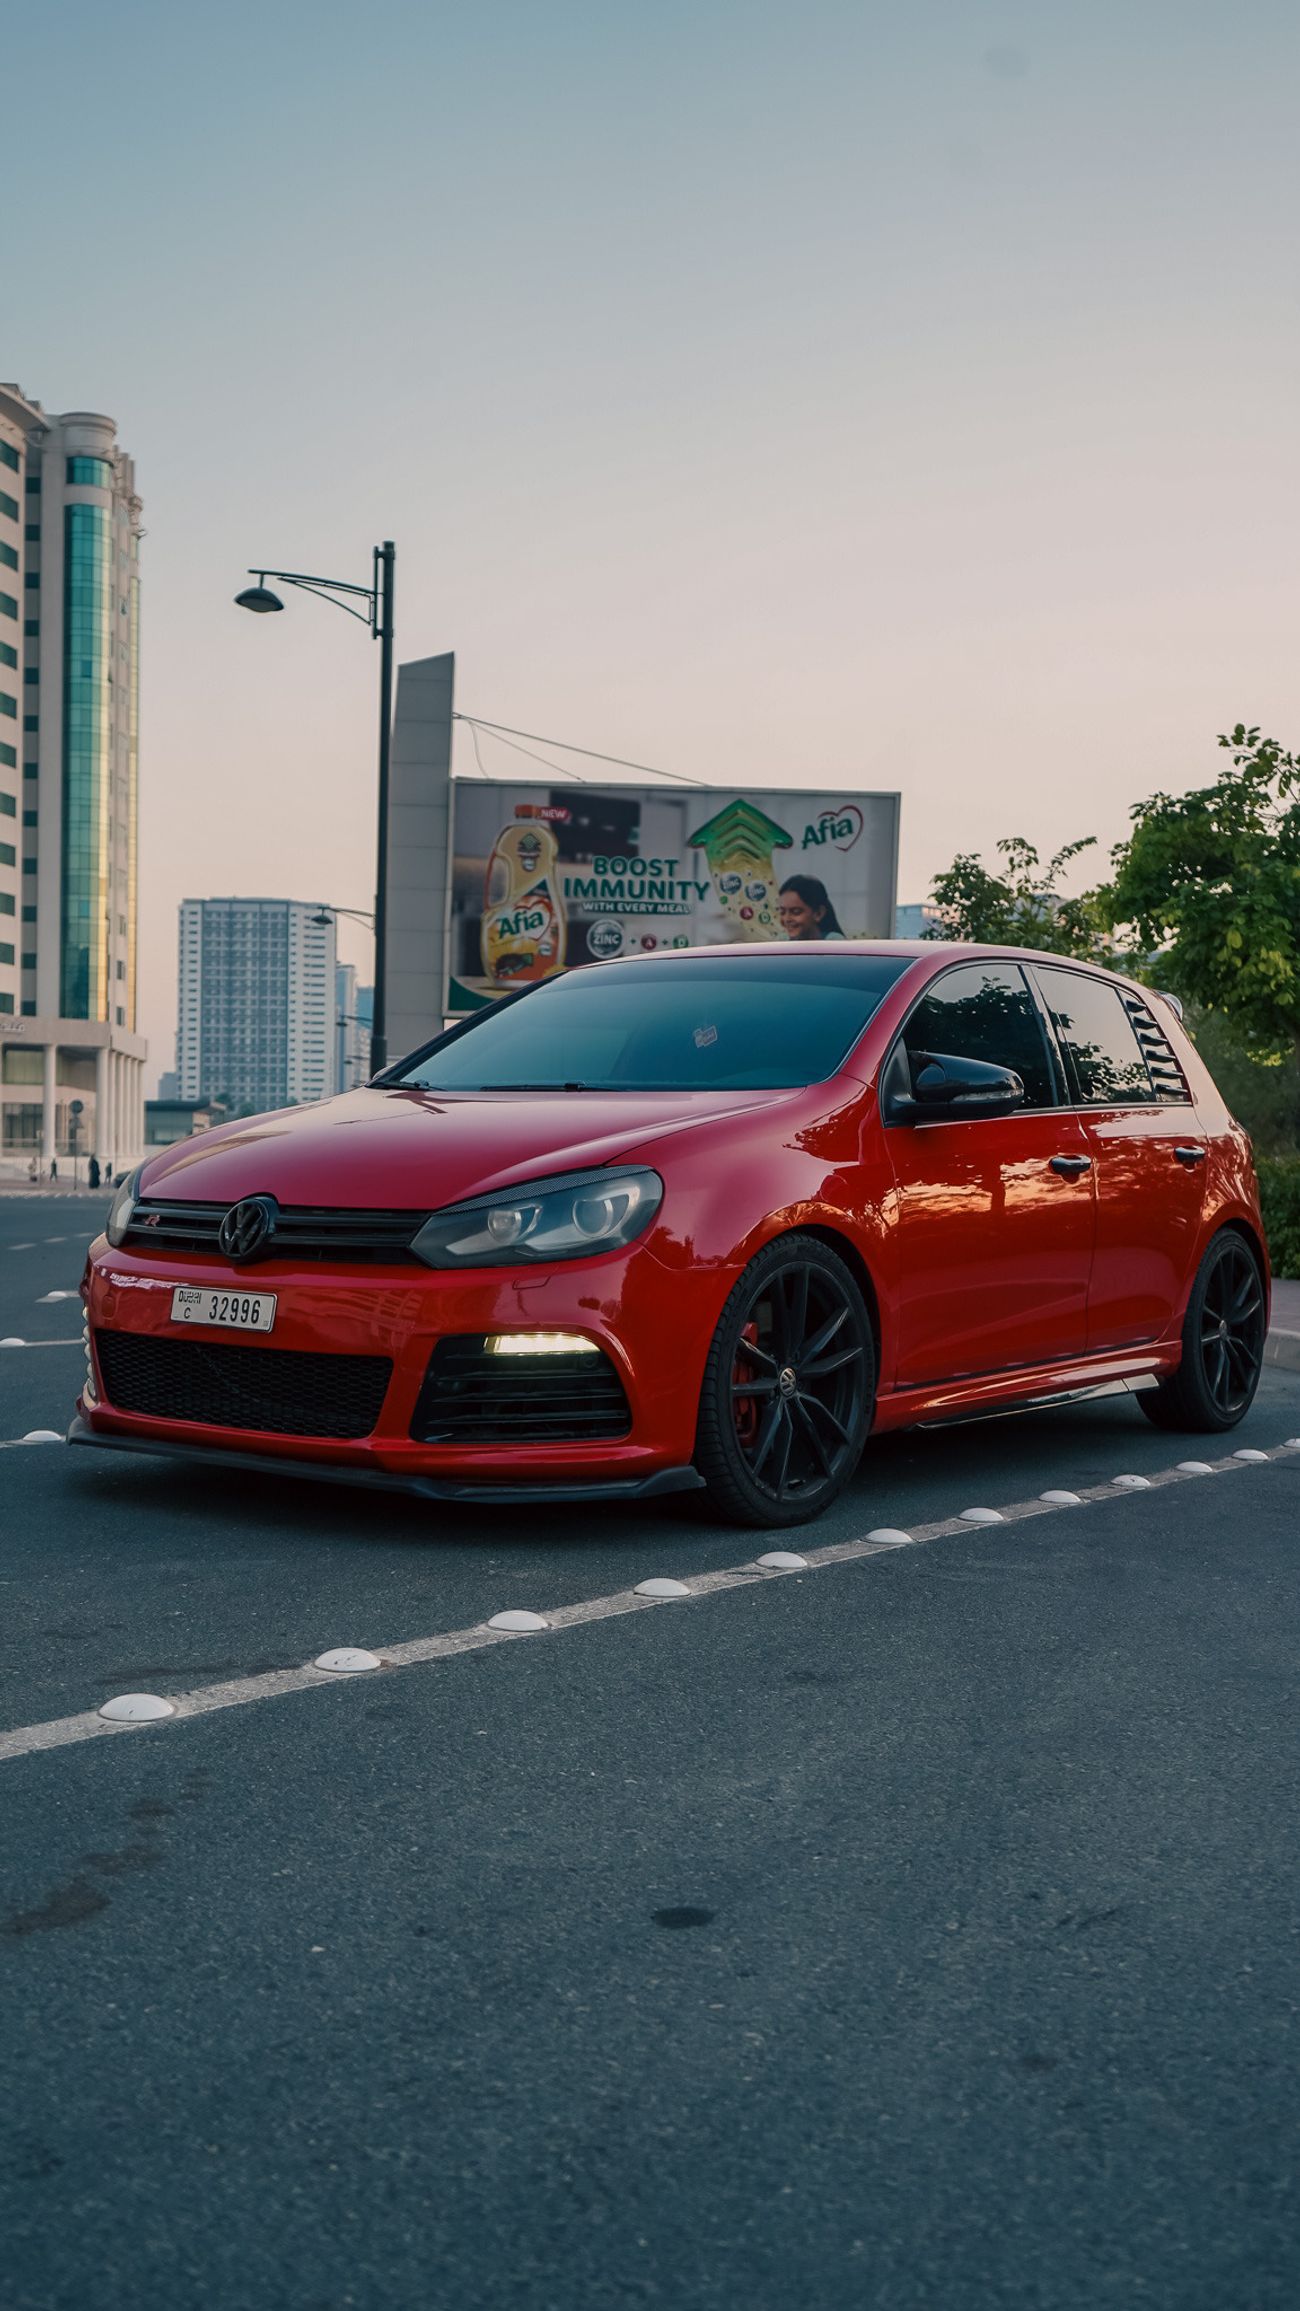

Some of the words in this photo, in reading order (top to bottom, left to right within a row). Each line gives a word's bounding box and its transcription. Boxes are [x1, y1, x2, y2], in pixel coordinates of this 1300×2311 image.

[541, 809, 567, 819] NEW
[802, 816, 854, 850] Afia
[593, 857, 679, 877] BOOST
[564, 877, 710, 901] IMMUNITY
[583, 902, 614, 911] WITH
[617, 903, 654, 913] EVERY
[657, 904, 691, 913] MEAL
[496, 910, 544, 939] Afia
[593, 934, 621, 945] ZINC
[184, 1307, 191, 1319] C
[209, 1296, 260, 1324] 32996
